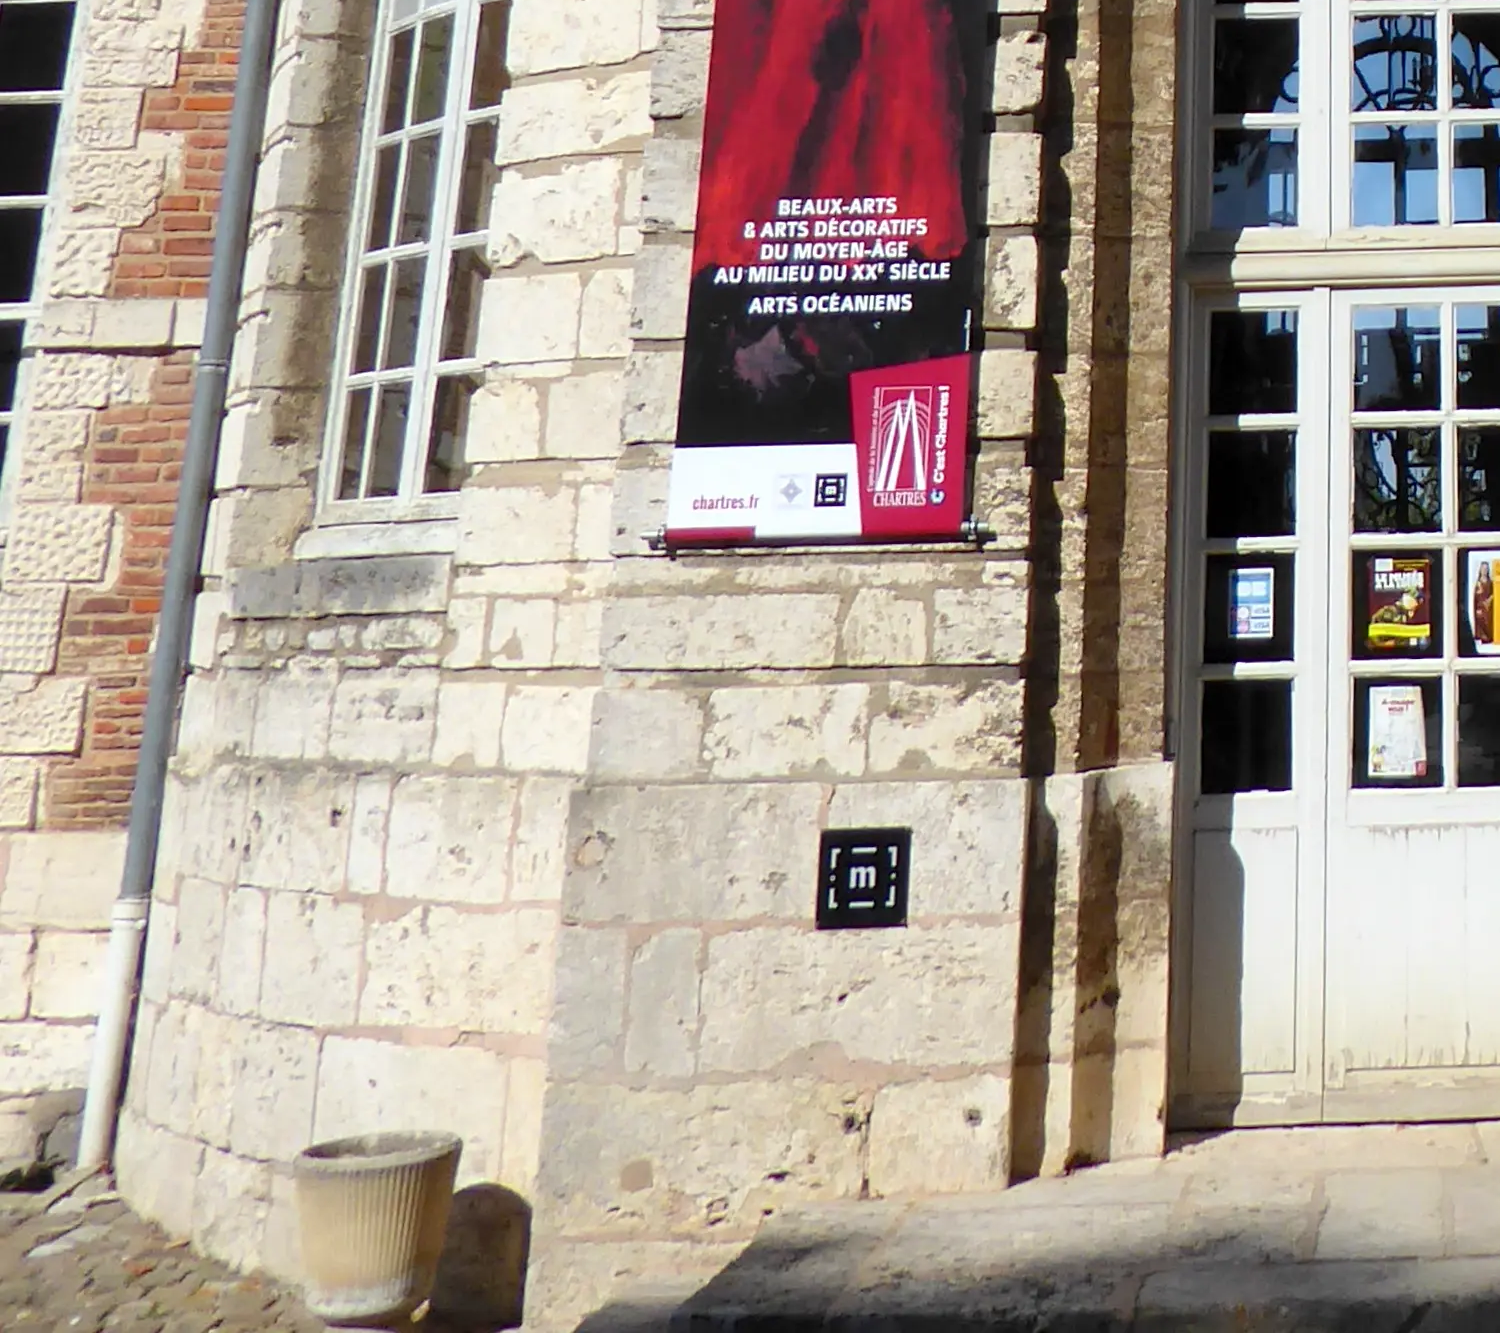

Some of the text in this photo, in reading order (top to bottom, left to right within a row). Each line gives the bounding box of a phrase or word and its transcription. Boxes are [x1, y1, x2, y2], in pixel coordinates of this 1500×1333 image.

[778, 197, 898, 216] BEAUX-ARTS
[744, 217, 928, 238] & ARTS DÉCORATIFS
[760, 239, 909, 260] DU MOYEN-ÂGE
[714, 267, 742, 283] AU
[749, 265, 814, 283] MILIEU
[819, 264, 847, 282] DU
[889, 260, 950, 280] SIÈCLE
[748, 293, 912, 314] ARTS OCÉANIENS
[692, 494, 760, 510] chartres.fr
[873, 491, 927, 507] CHARTRES
